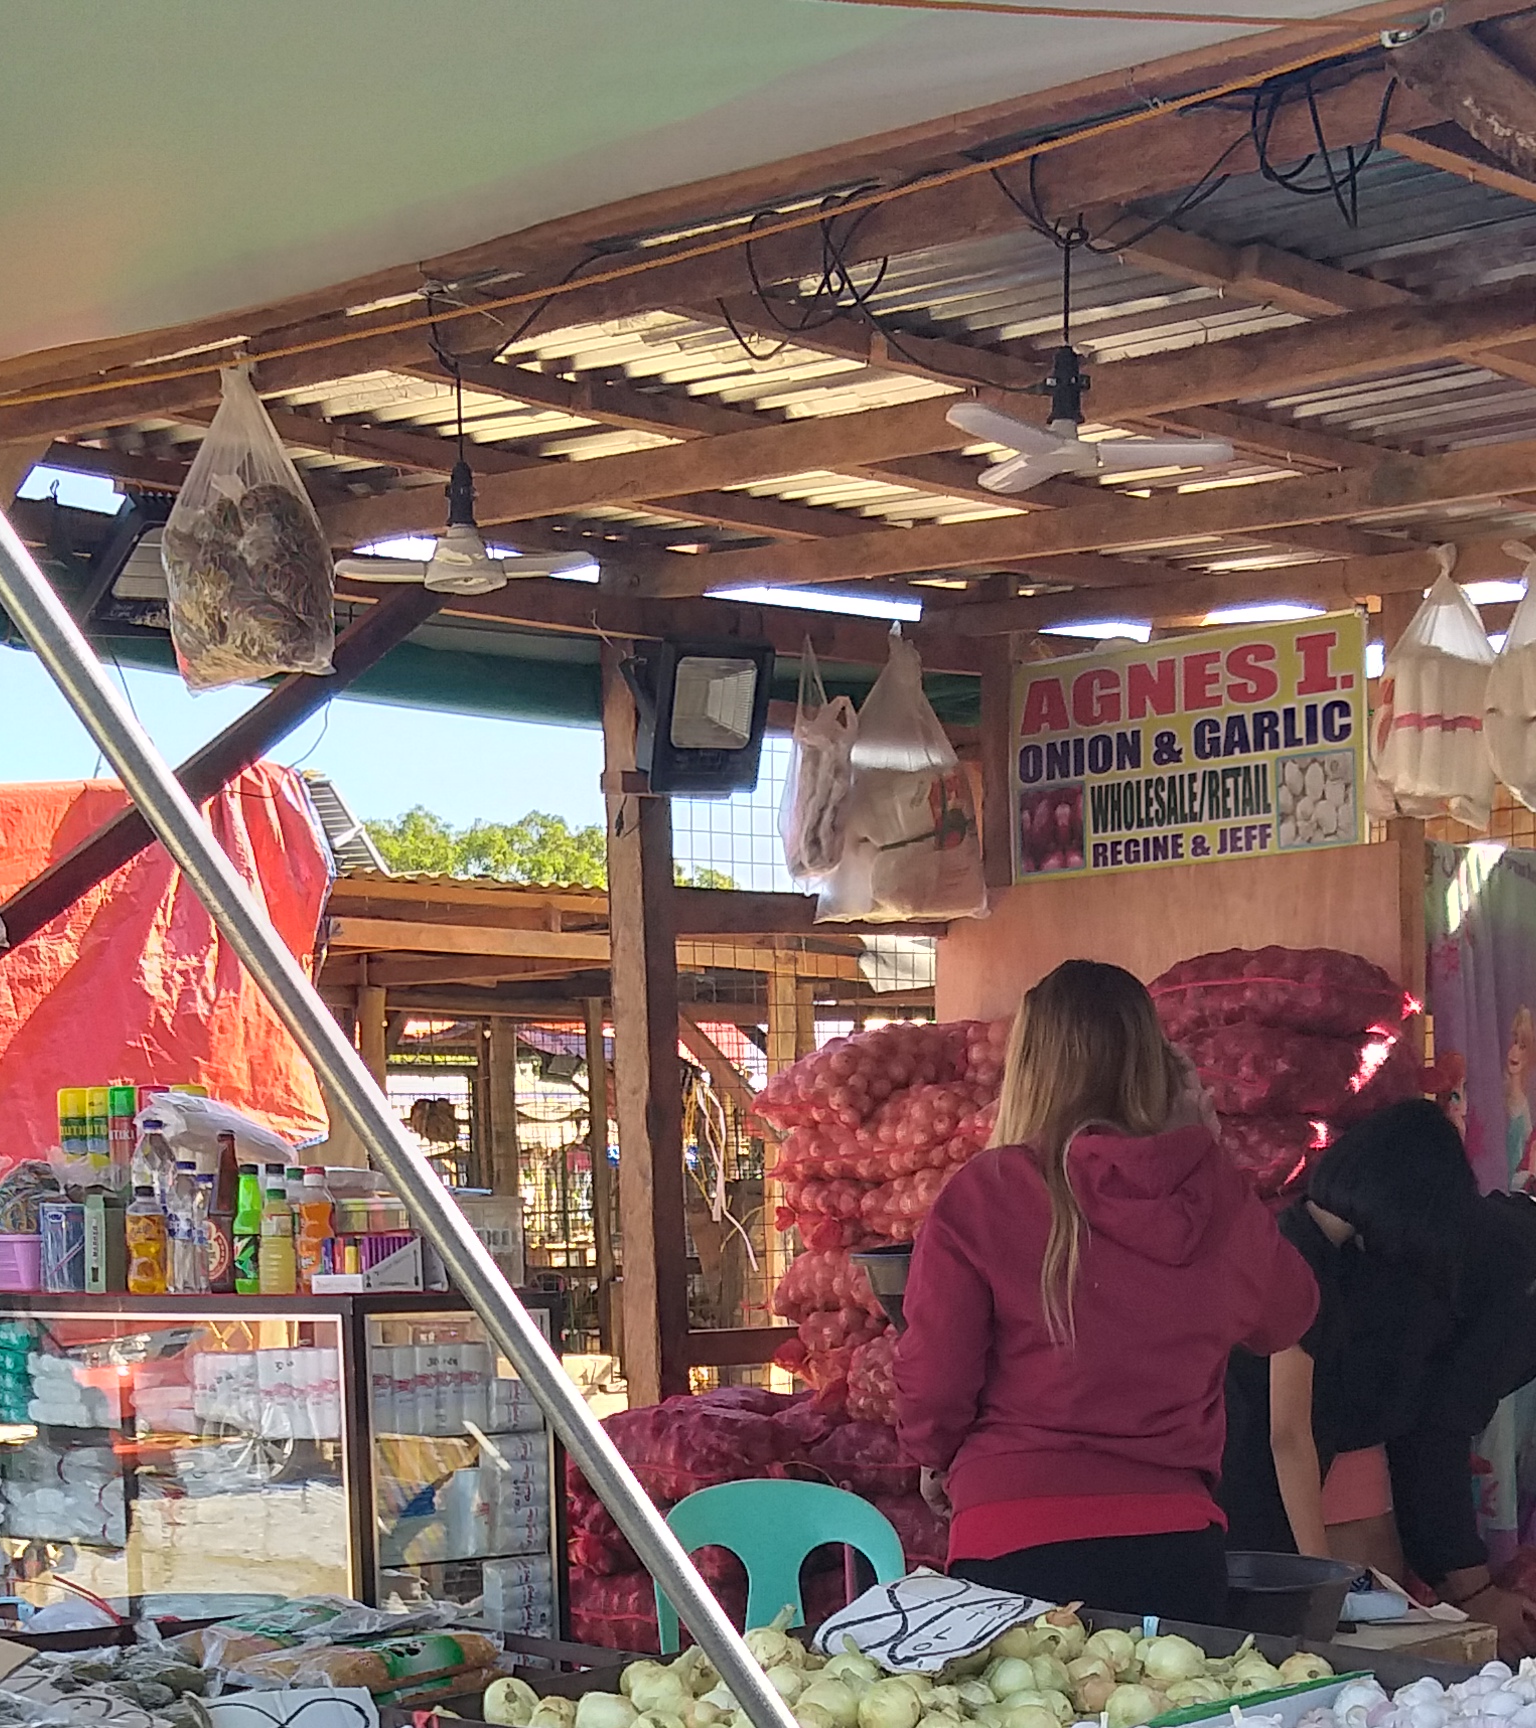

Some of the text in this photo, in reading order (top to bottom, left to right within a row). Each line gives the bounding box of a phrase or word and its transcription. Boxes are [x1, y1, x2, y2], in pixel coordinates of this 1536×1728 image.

[1020, 631, 1355, 736] AGNES I.
[1018, 699, 1353, 784] ONION & GARLIC
[1090, 762, 1272, 834] WHOLESALE/RETAIL
[1092, 823, 1273, 868] REGINE & JEFF
